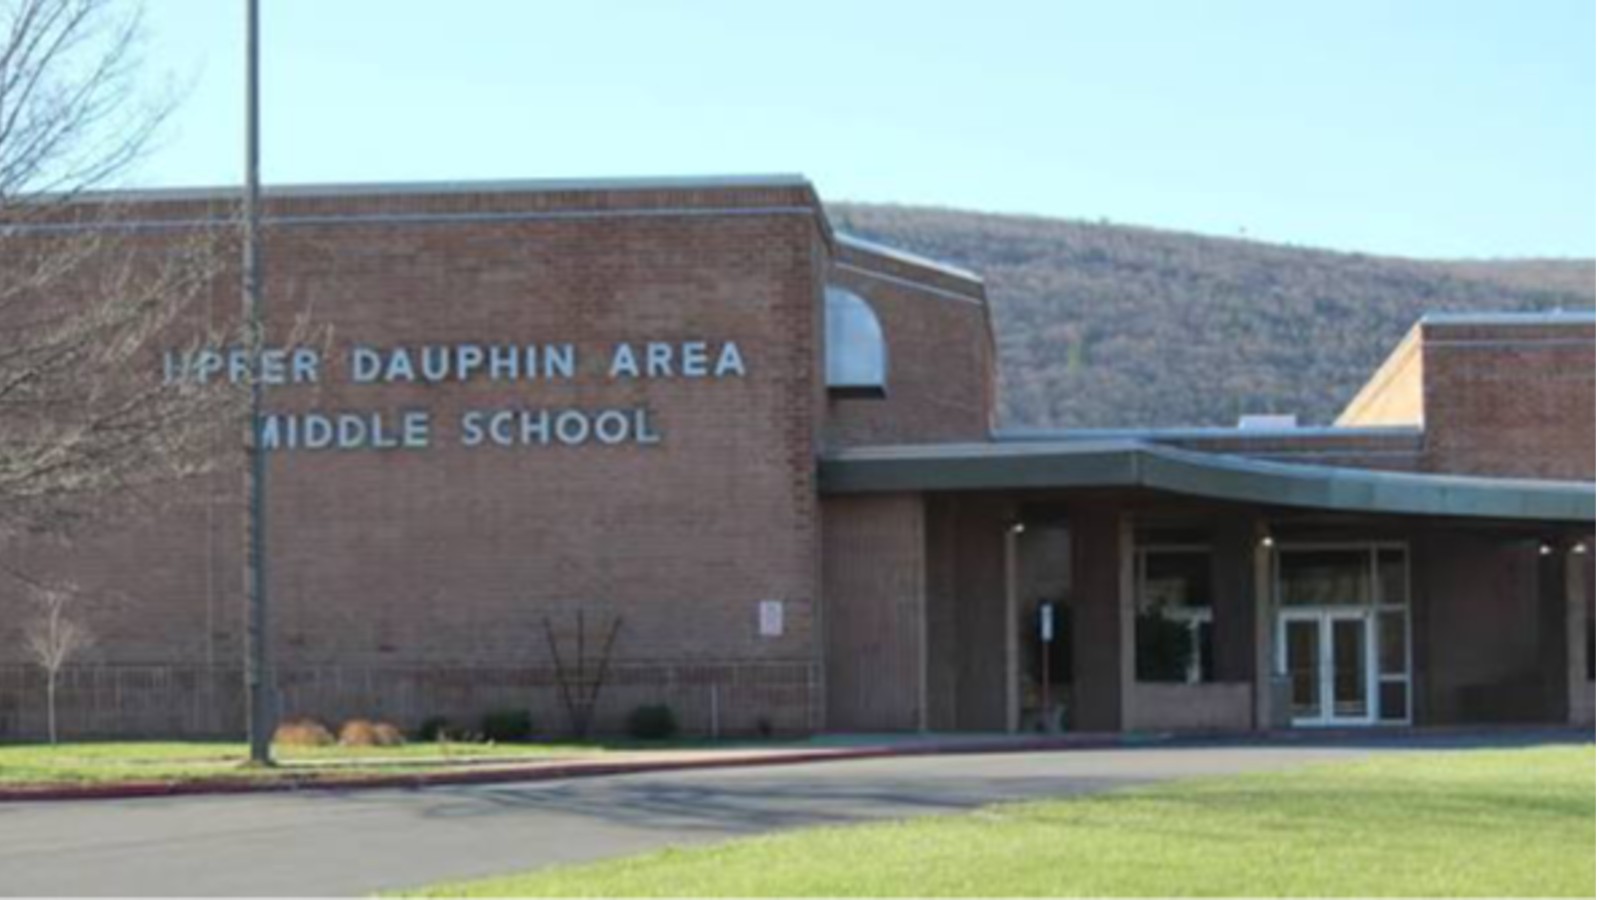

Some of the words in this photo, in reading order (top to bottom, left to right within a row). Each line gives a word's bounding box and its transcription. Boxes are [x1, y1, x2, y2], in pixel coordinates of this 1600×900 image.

[352, 344, 576, 383] DAUPHIN
[609, 341, 746, 377] AREA
[461, 409, 660, 446] SCHOOL
